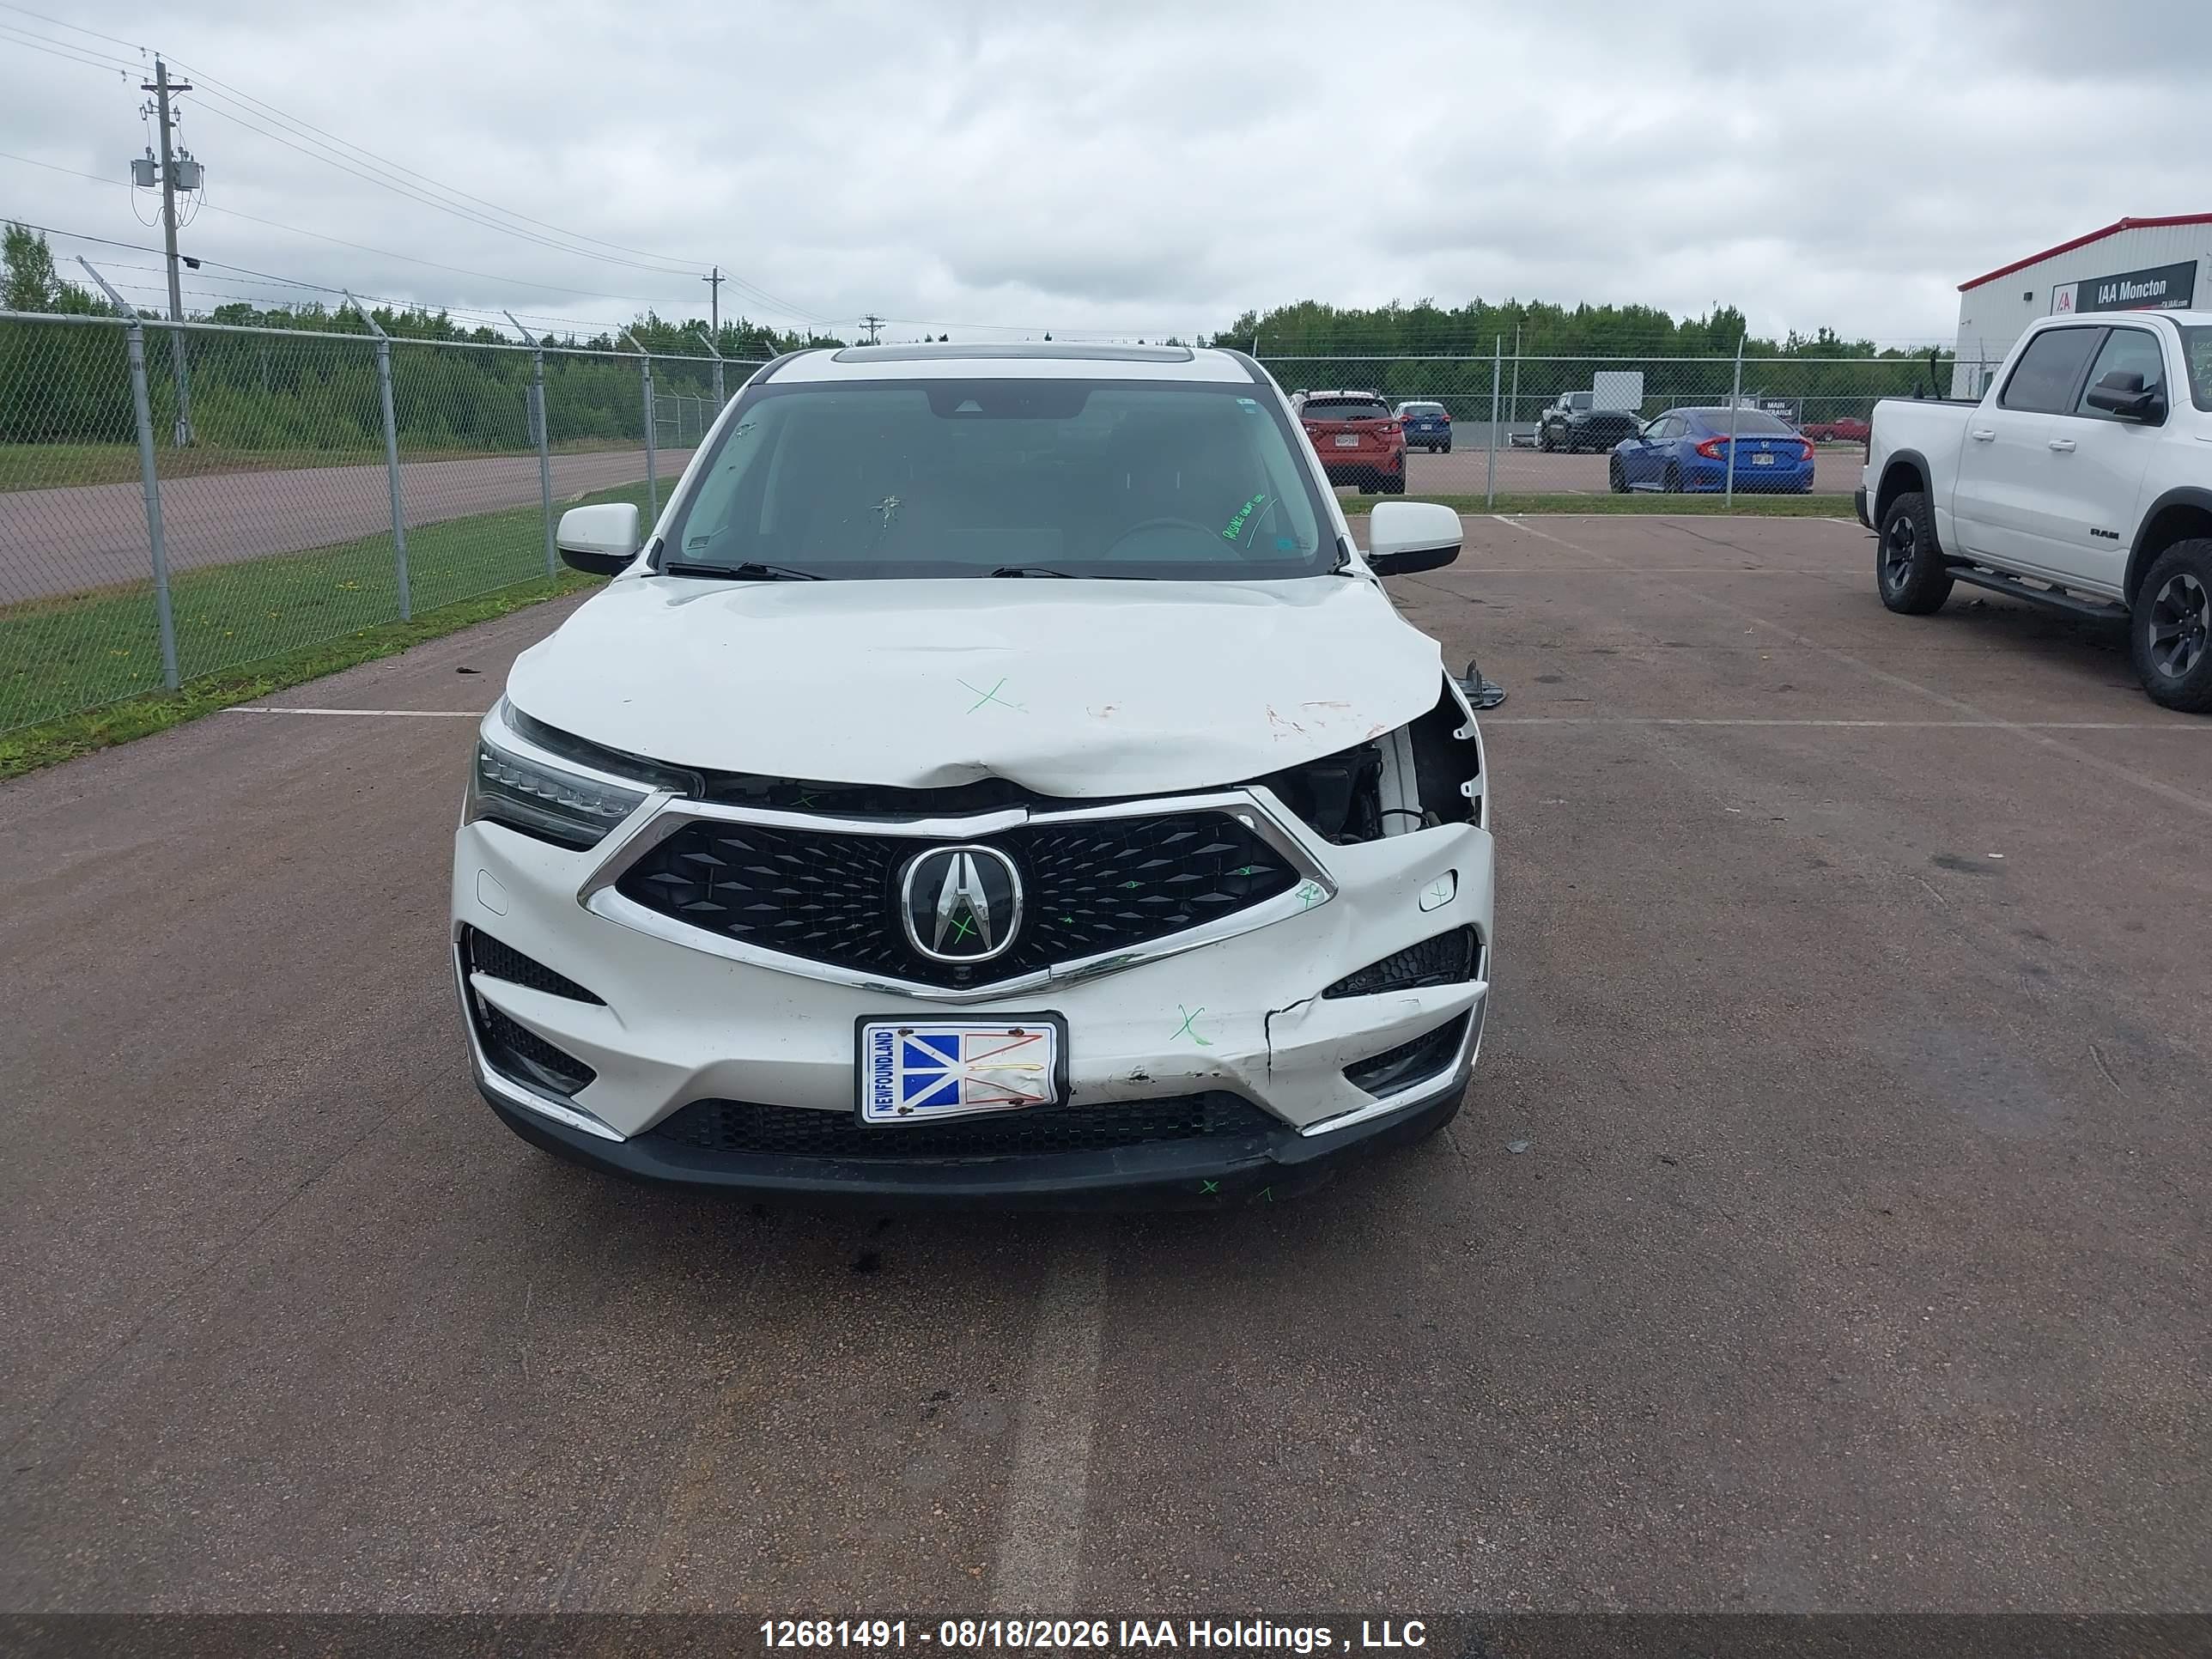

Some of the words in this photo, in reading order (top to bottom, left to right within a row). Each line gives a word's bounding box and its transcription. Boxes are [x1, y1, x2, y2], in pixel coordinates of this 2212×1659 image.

[2098, 282, 2117, 304] IAA
[2119, 280, 2166, 301] Moncton
[2090, 528, 2119, 540] RAM
[874, 1032, 894, 1111] NEWFOUNDLAND
